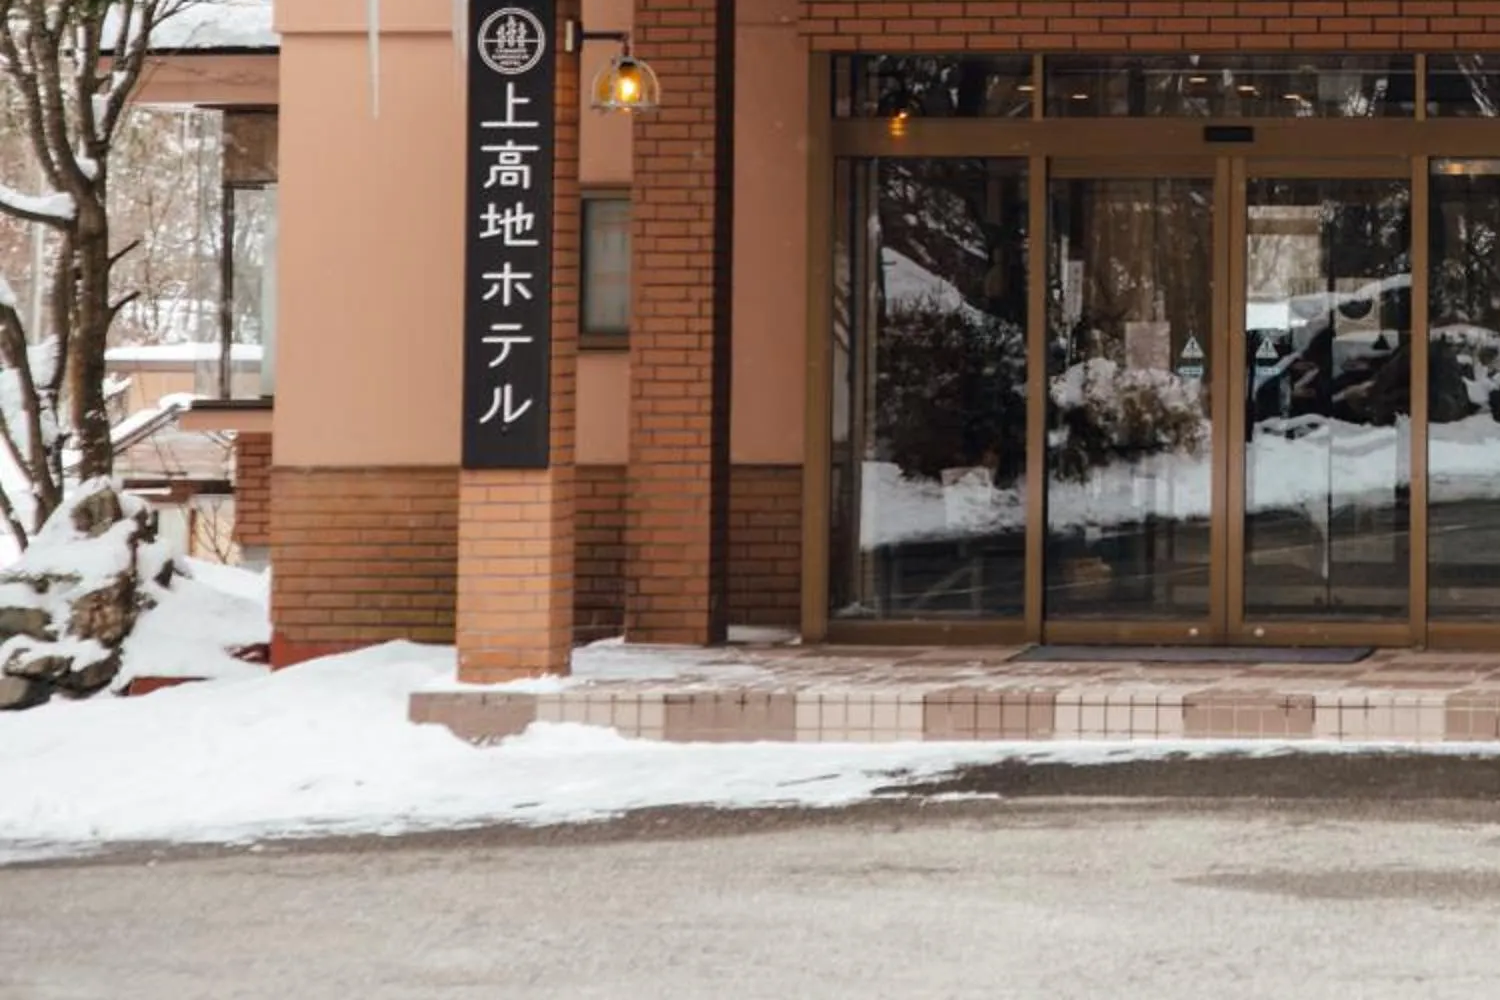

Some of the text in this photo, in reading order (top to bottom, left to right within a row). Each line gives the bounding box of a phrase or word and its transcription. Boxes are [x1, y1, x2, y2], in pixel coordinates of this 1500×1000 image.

[479, 81, 540, 424] 上高地ホテル
